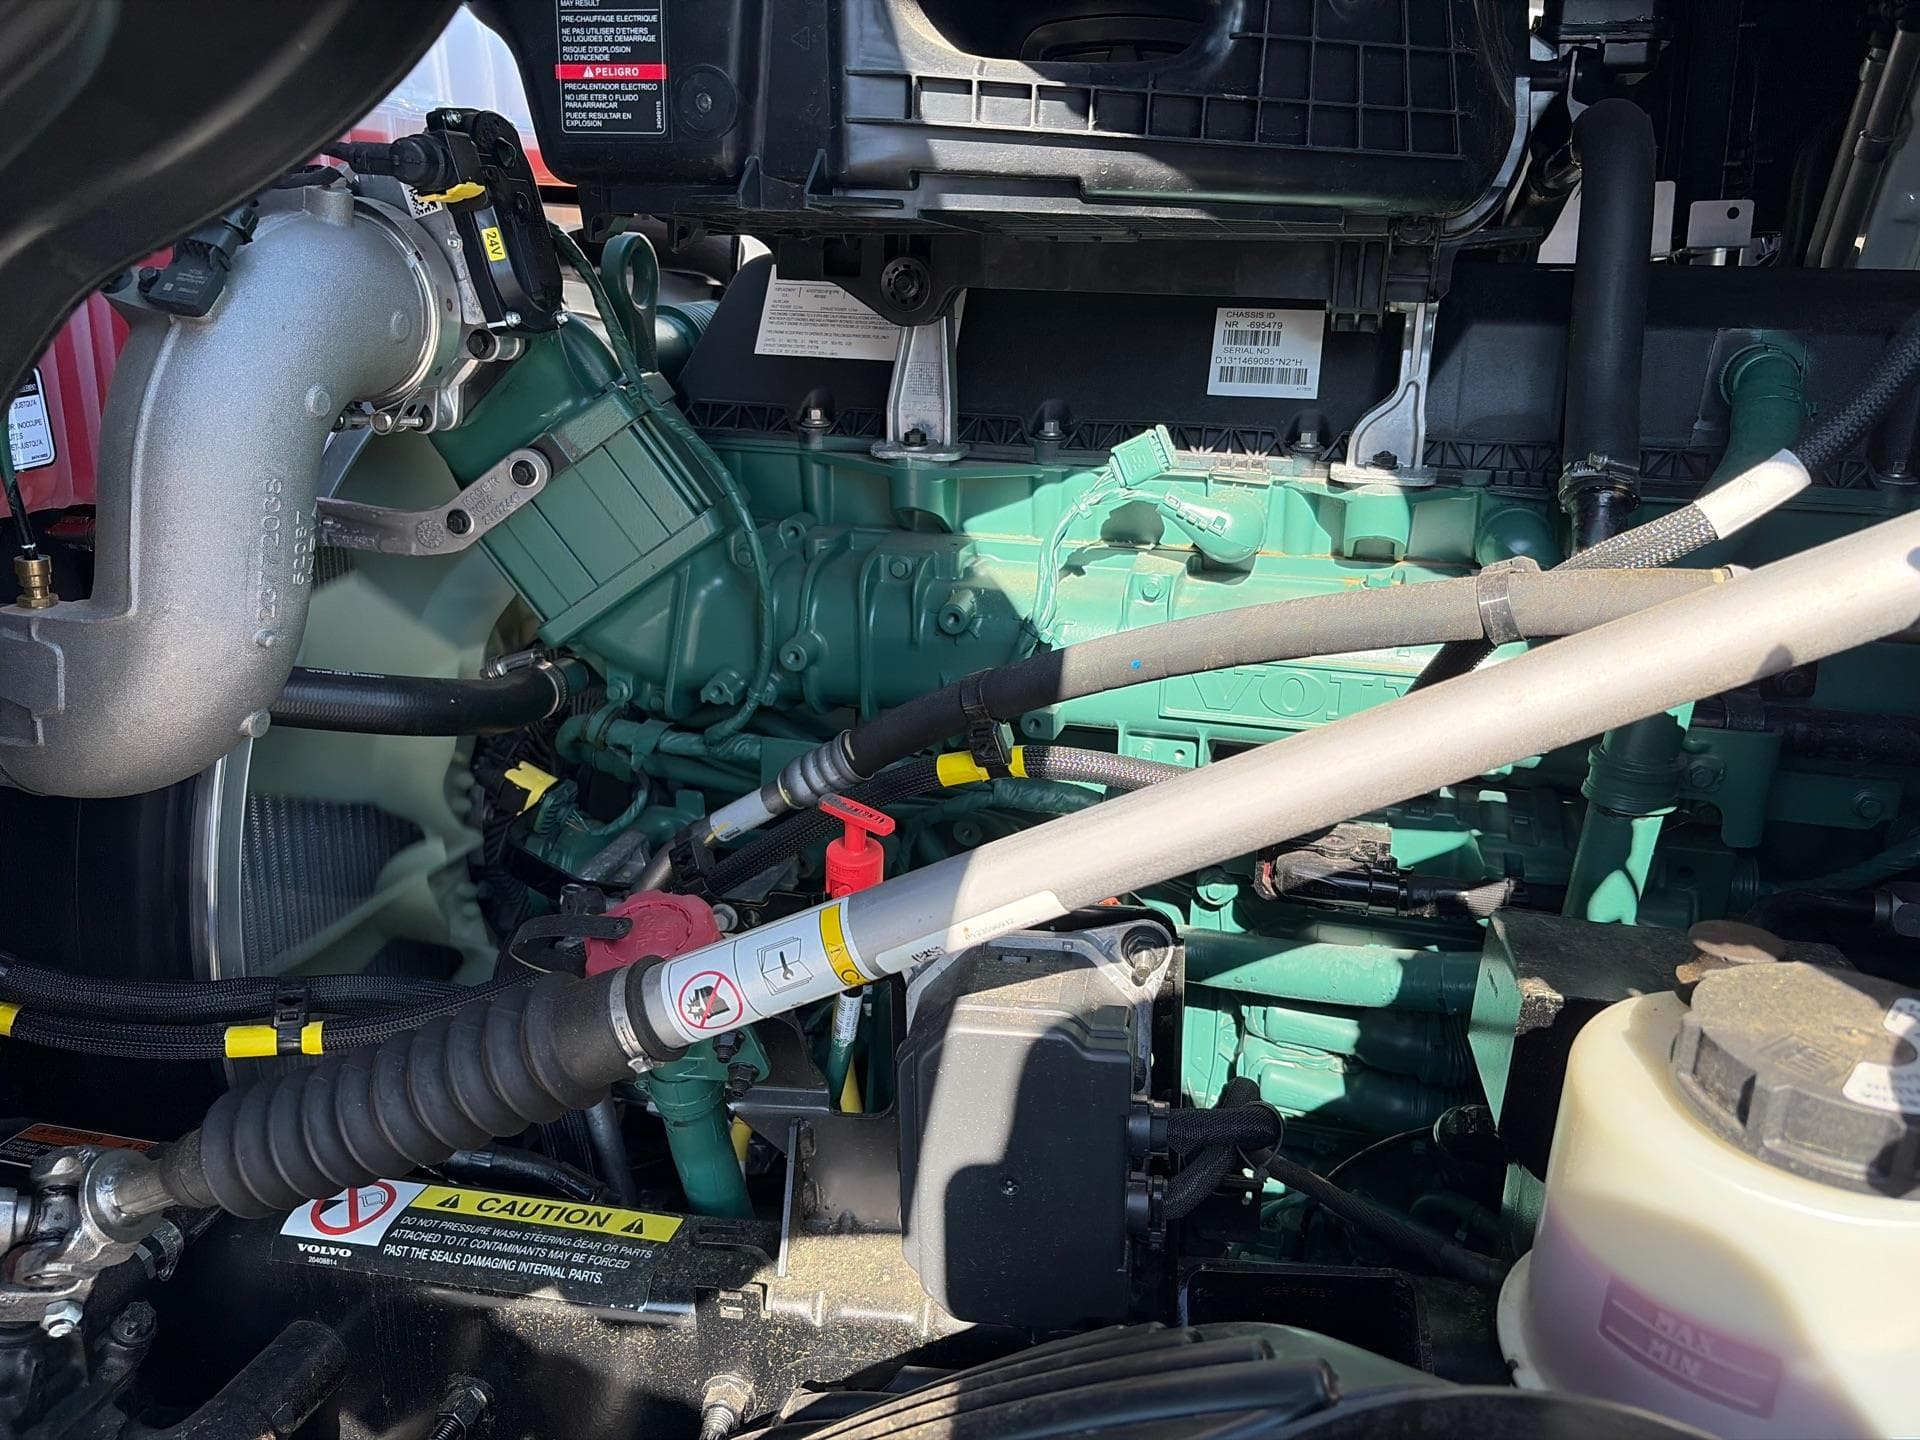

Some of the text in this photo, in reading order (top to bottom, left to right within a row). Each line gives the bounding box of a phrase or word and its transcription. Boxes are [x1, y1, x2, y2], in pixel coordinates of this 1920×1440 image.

[561, 15, 615, 23] PRE-CHAUFFAGE
[586, 27, 615, 35] UTILISER
[595, 68, 639, 76] PELIGRO
[565, 83, 620, 91] PRECALENTADOR
[485, 231, 503, 256] 24V
[1226, 311, 1265, 319] CHASSIS
[1224, 321, 1283, 330] NR -695479
[1223, 346, 1270, 355] SERIAL NO
[477, 1197, 613, 1228] CAUTION
[400, 1215, 653, 1259] DO NOT PRESSURE WASH STEERING GEAR OR PARTS
[297, 1243, 352, 1257] VOLVO
[390, 1228, 631, 1269] ATTACHED TO IT. CONTAMINANTS MAY BE FORCED
[383, 1243, 604, 1285] PAST THE SEALS DAMAGING INTERNAL PARTS.
